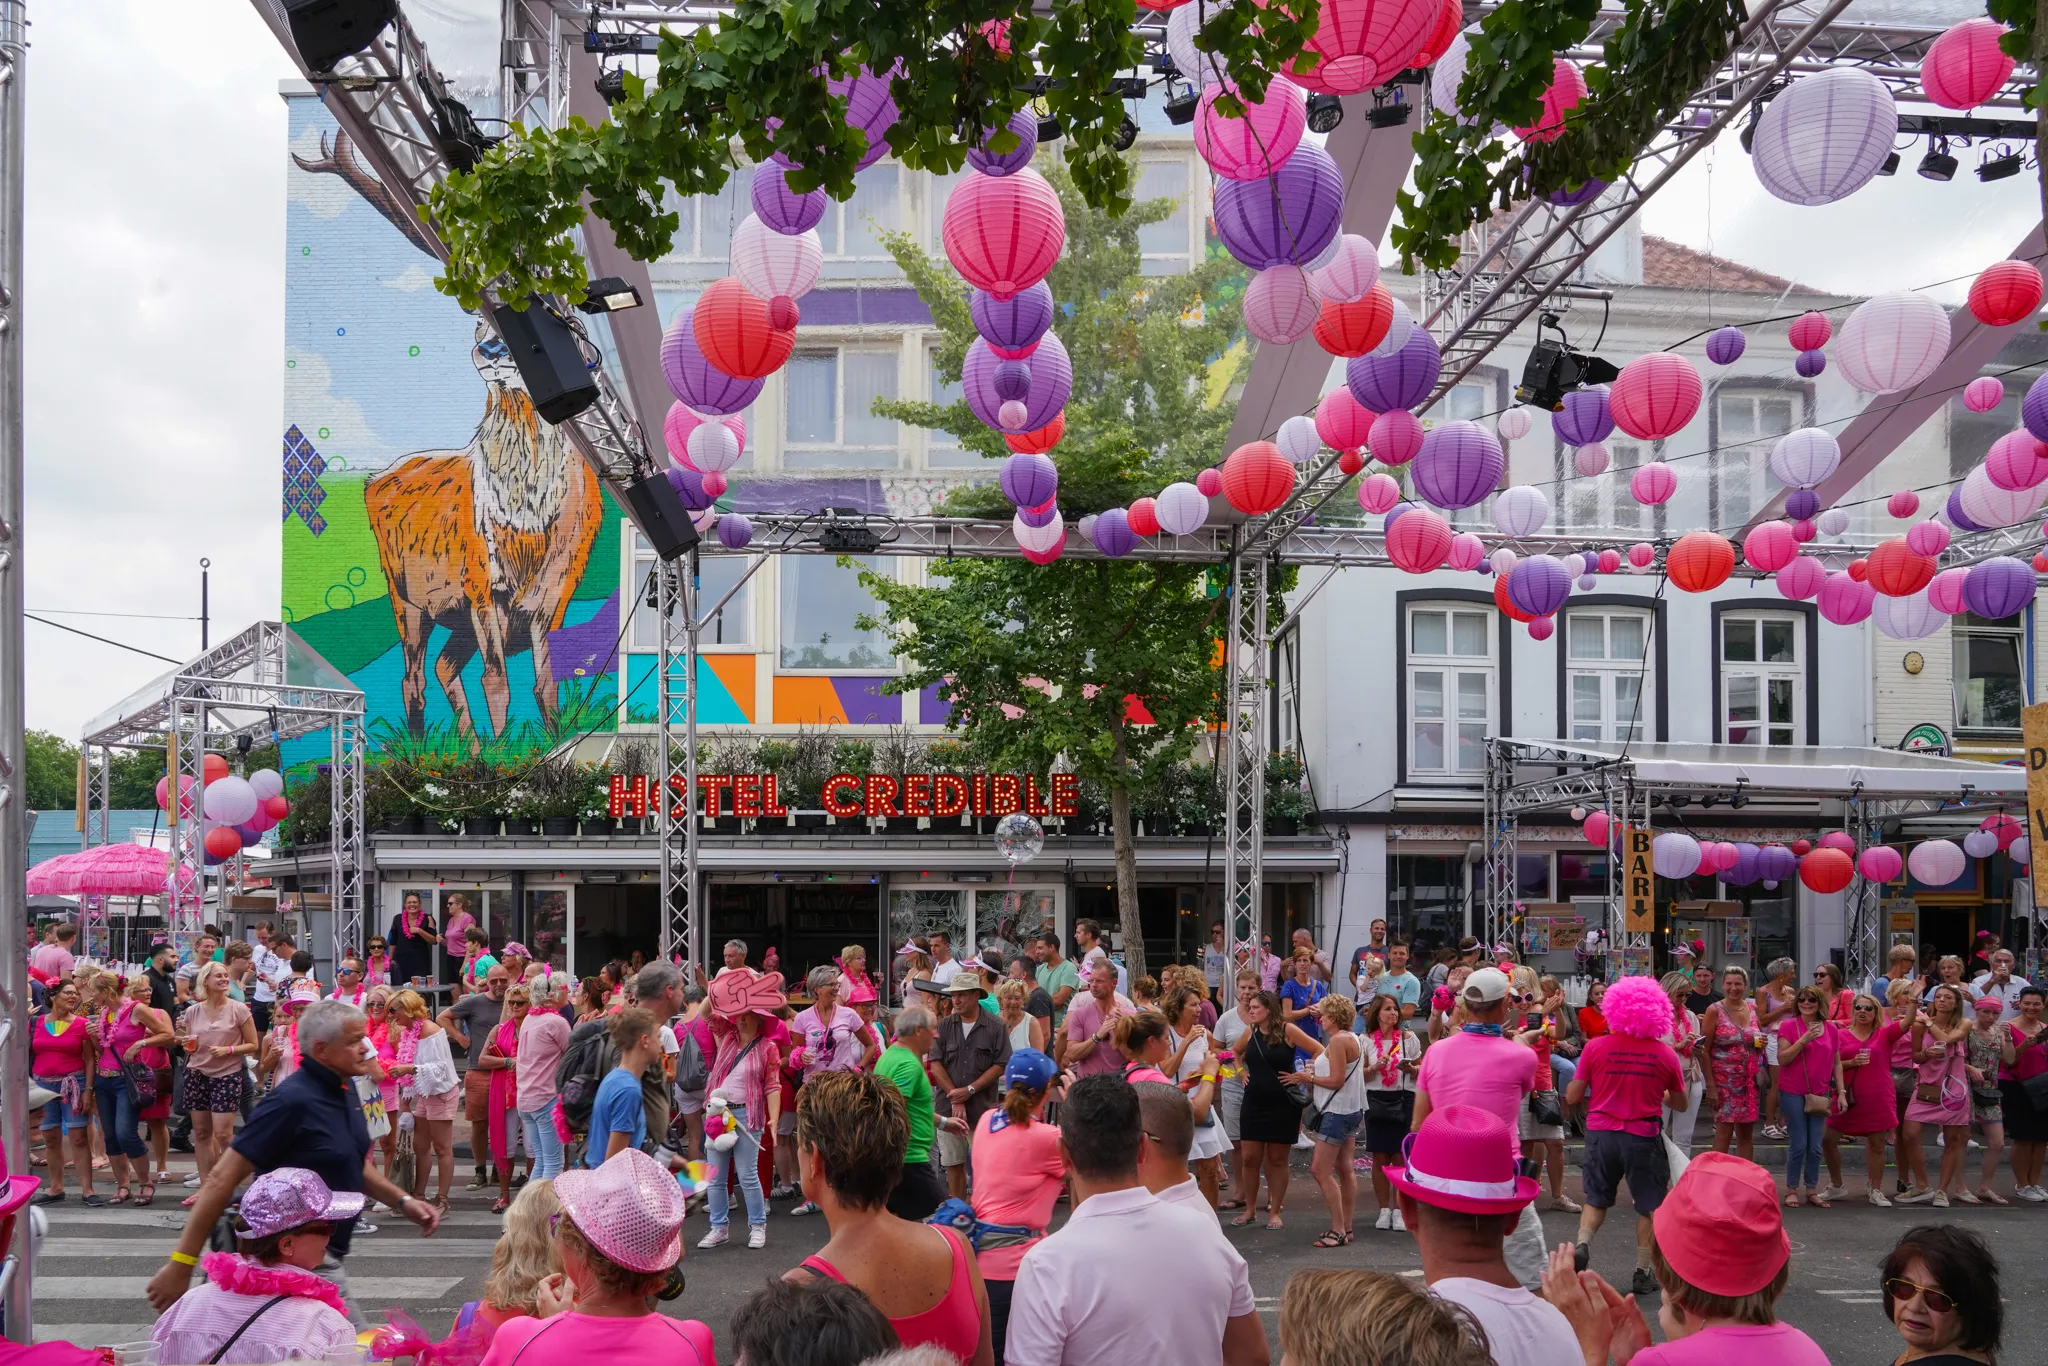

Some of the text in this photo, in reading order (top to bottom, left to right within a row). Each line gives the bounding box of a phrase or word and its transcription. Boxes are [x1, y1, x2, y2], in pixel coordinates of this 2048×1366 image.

[610, 773, 1079, 818] HOTEL CREDIBLE
[1631, 833, 1650, 897] BAR
